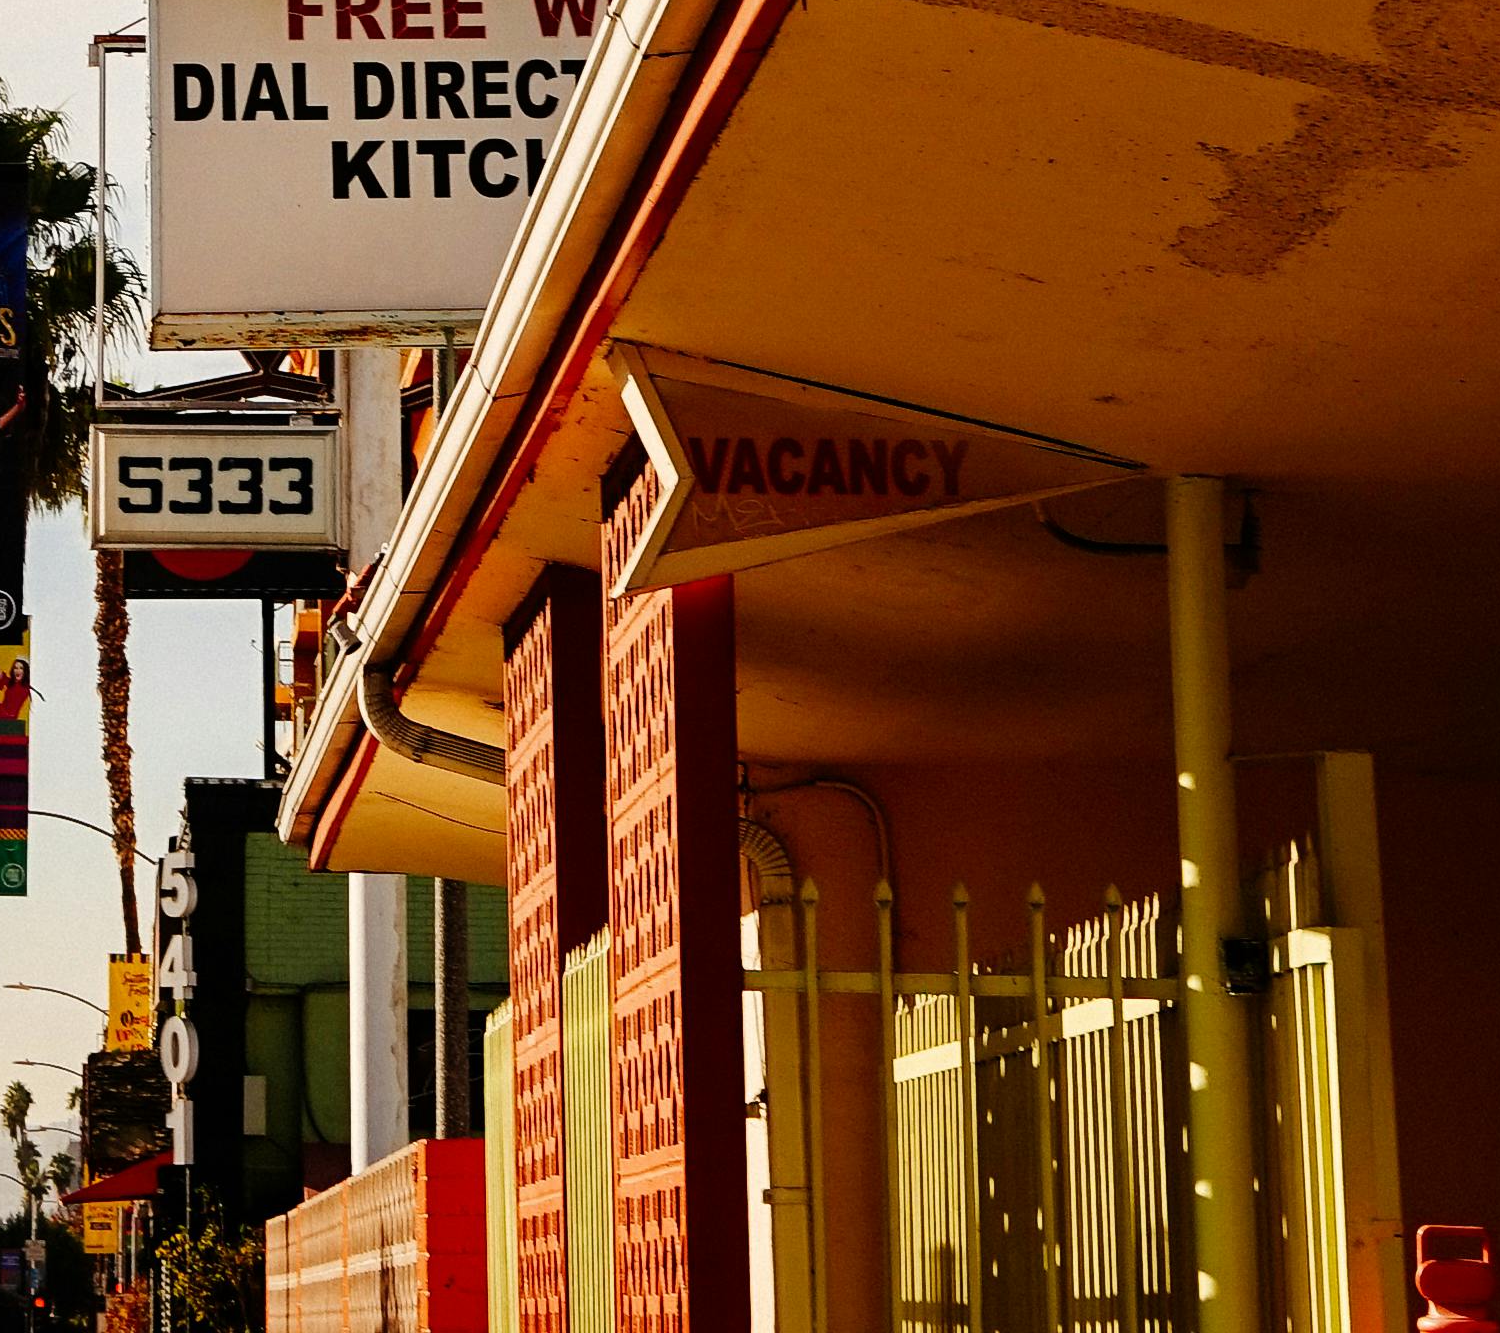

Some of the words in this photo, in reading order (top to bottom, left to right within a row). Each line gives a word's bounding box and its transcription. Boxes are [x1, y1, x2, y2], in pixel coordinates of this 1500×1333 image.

[172, 62, 330, 122] DIAL
[117, 455, 315, 516] 5333
[687, 437, 970, 497] VACANCY
[161, 851, 198, 1166] 5401
